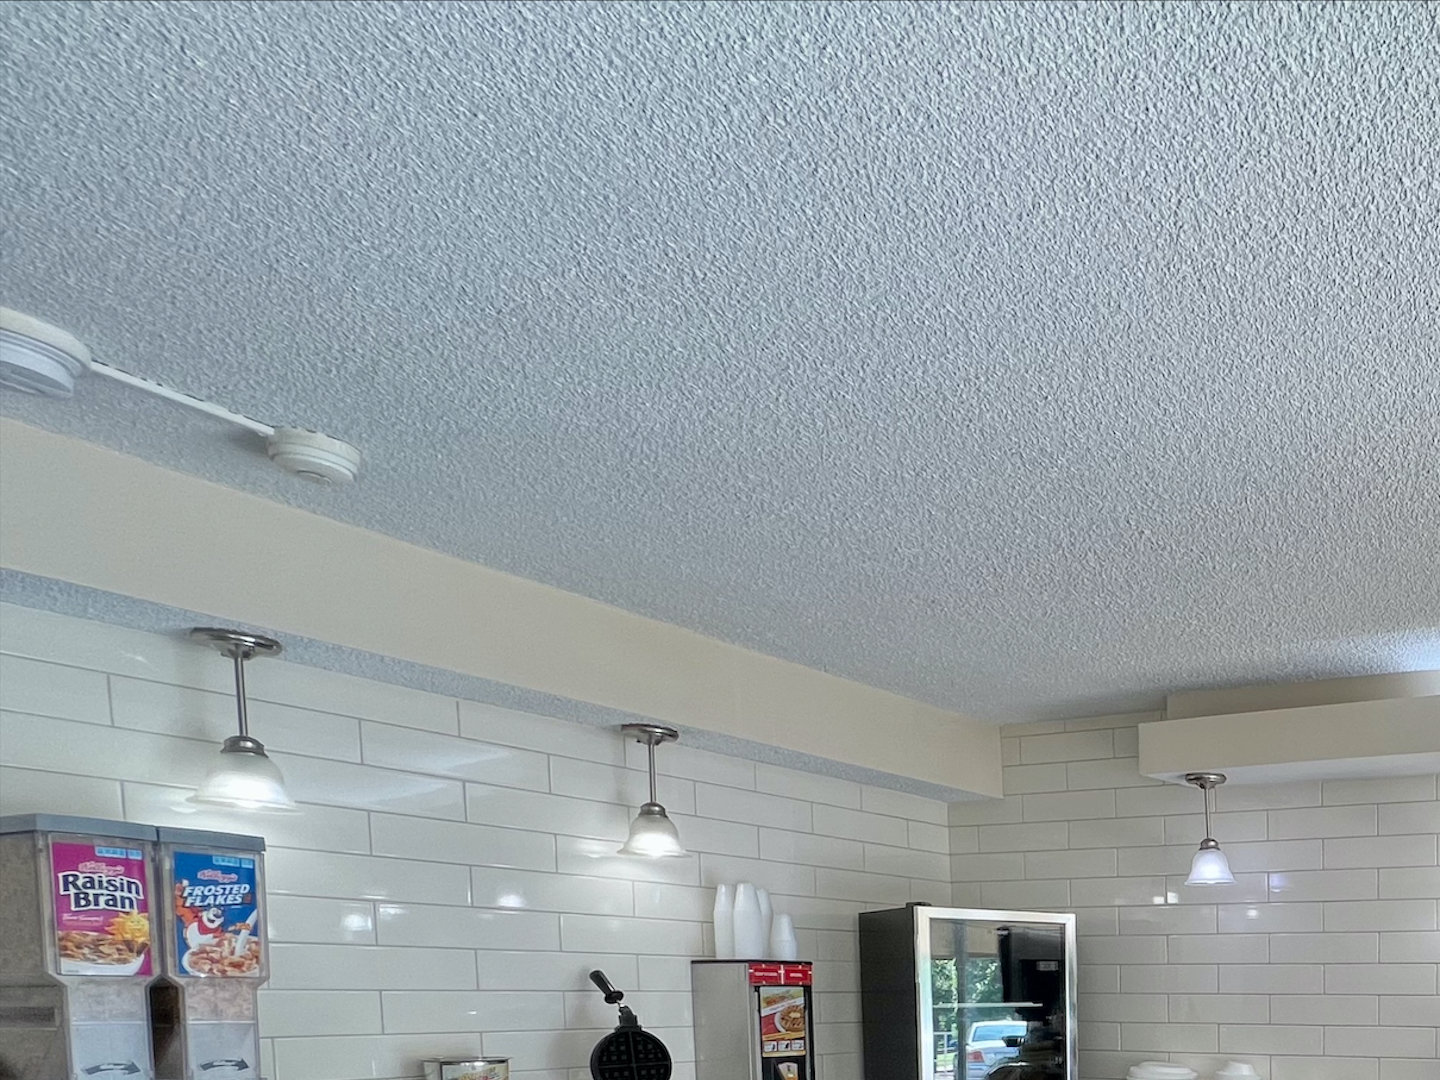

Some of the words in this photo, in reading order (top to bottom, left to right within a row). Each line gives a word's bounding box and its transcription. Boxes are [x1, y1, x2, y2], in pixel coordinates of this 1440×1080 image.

[61, 872, 143, 898] Raisin
[182, 883, 251, 897] FROSTED
[73, 891, 136, 911] Bran
[185, 893, 244, 907] FLAKES
